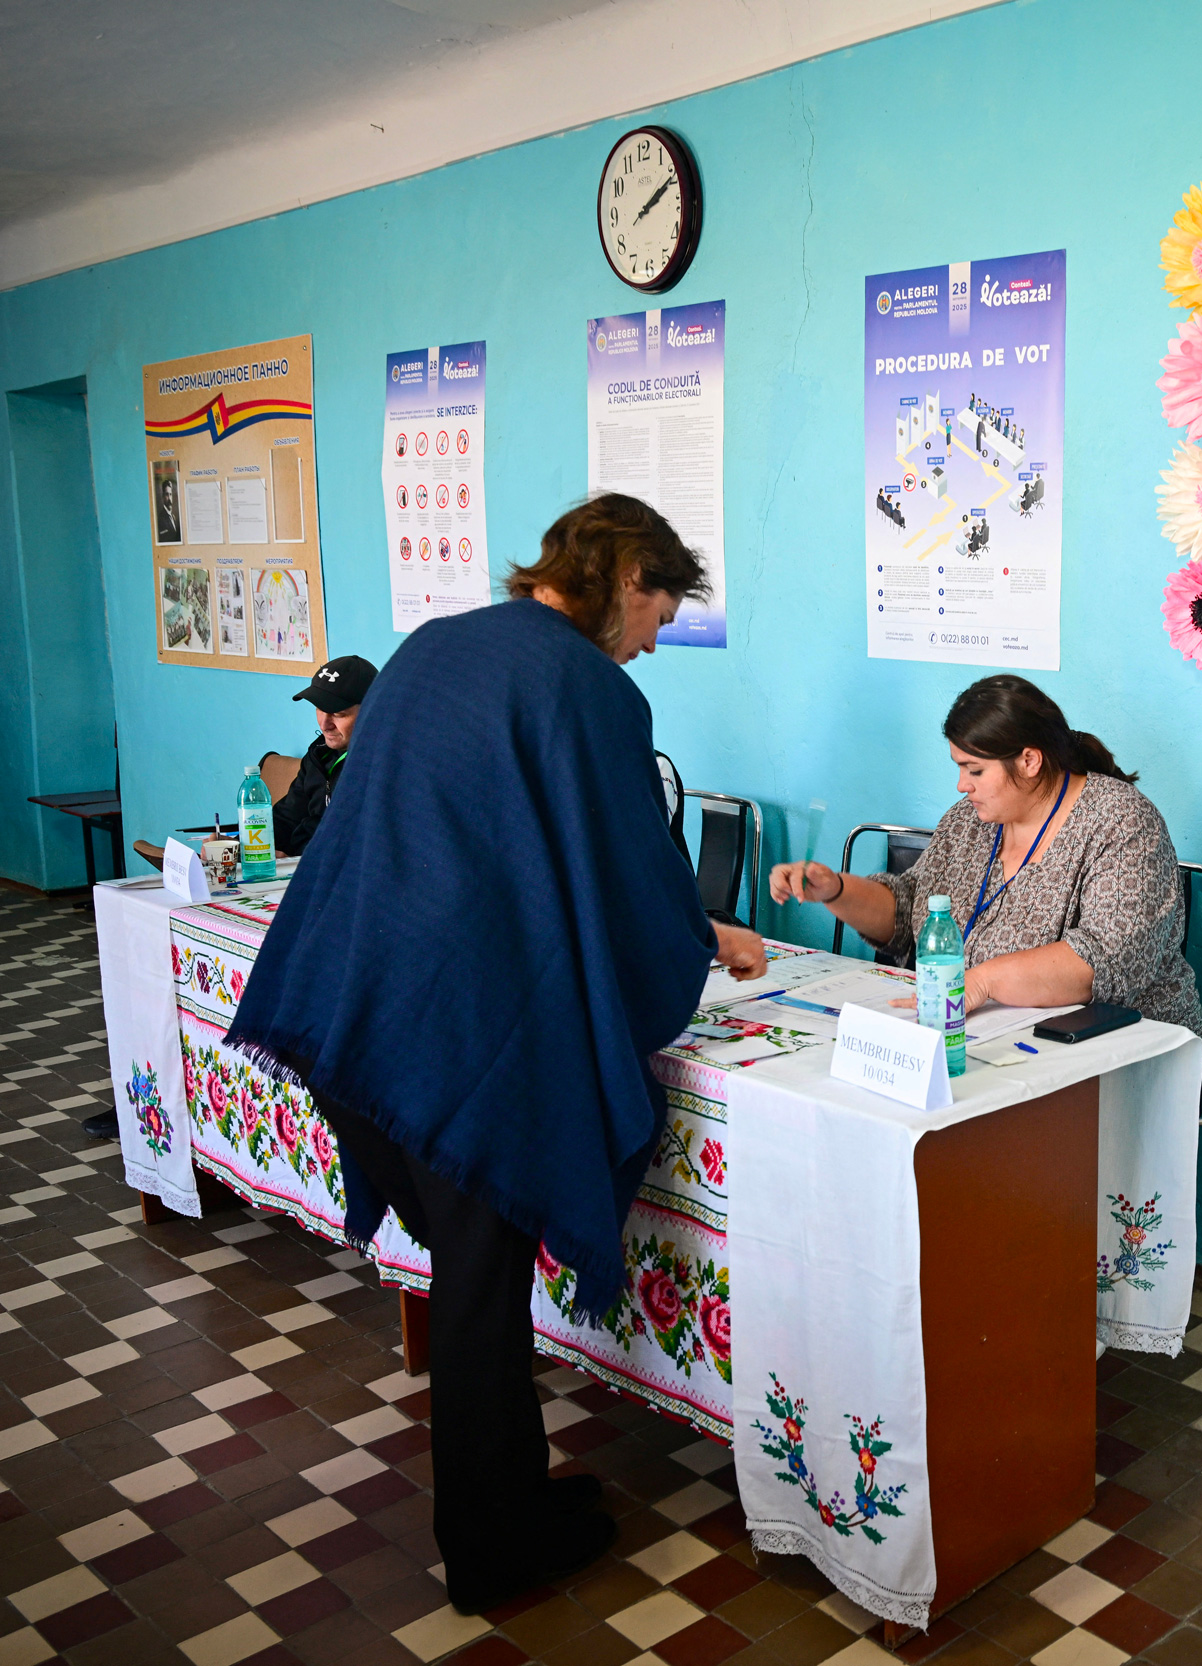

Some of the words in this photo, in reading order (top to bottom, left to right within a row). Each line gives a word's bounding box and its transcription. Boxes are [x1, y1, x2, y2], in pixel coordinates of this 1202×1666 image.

[637, 140, 650, 162] 12
[658, 146, 663, 166] 1
[623, 153, 633, 175] 11
[668, 163, 678, 185] 2
[613, 177, 624, 198] 10
[610, 206, 619, 228] 9
[671, 221, 679, 240] 4
[617, 234, 627, 255] 8
[629, 254, 637, 274] 7
[662, 248, 670, 267] 5
[645, 259, 654, 278] 6
[894, 285, 939, 301] ALEGERI
[952, 282, 967, 295] 28
[894, 310, 917, 318] REPUBLICII
[917, 307, 938, 316] MOLDOVA
[903, 299, 938, 309] PARLAMENTUL
[952, 303, 967, 311] 2025
[608, 327, 639, 341] ALEGERI
[648, 325, 658, 337] 28
[401, 362, 424, 373] ALEGERI
[429, 360, 437, 370] 28
[875, 351, 973, 375] PROCEDURA
[982, 348, 1005, 367] DE
[1014, 344, 1050, 364] VOT
[159, 364, 249, 395] ИНФОРМАЦИОННОЕ
[251, 358, 289, 380] ПАННО
[608, 381, 637, 395] CODUL
[639, 379, 652, 391] DE
[654, 370, 701, 390] CONDUITĂ
[608, 397, 613, 405] A
[613, 391, 664, 406] FUNCȚIONARILOR
[665, 388, 701, 400] ELECTORALI
[436, 407, 444, 418] SE
[445, 404, 478, 417] INTERZICE:
[940, 633, 960, 645] 0(22)
[960, 635, 970, 644] 88
[971, 635, 979, 644] 01
[980, 636, 989, 645] 01
[248, 829, 264, 845] K
[840, 1034, 891, 1062] MEMBRII
[893, 1051, 926, 1073] BESV
[863, 1063, 895, 1087] 10/034
